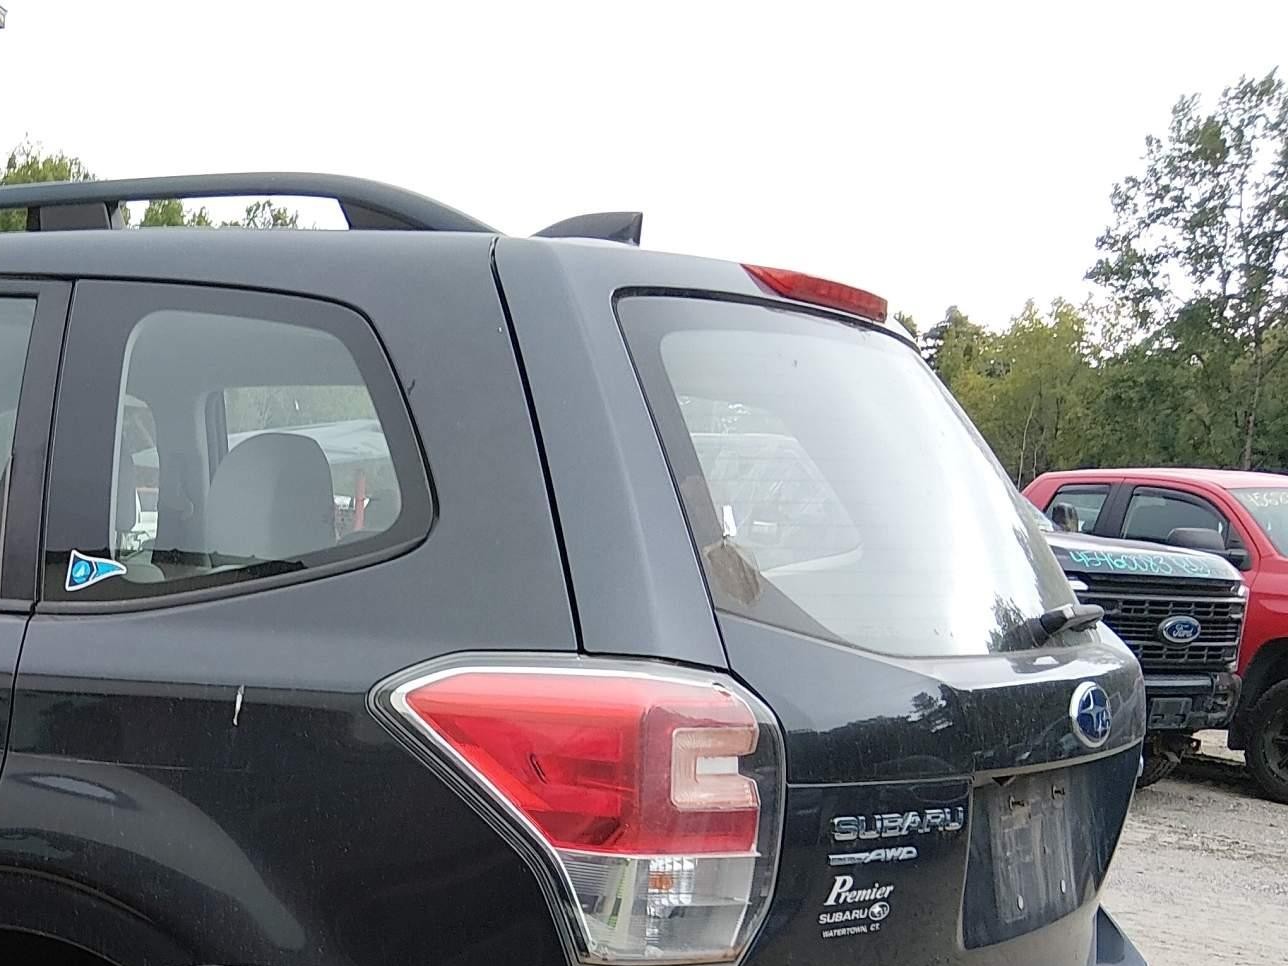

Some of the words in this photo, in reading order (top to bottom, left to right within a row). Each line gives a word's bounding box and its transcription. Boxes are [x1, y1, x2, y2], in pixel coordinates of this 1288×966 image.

[831, 806, 964, 841] SUBARU
[864, 846, 918, 863] AWD
[824, 875, 894, 906] Premier
[818, 908, 868, 925] SUBARU
